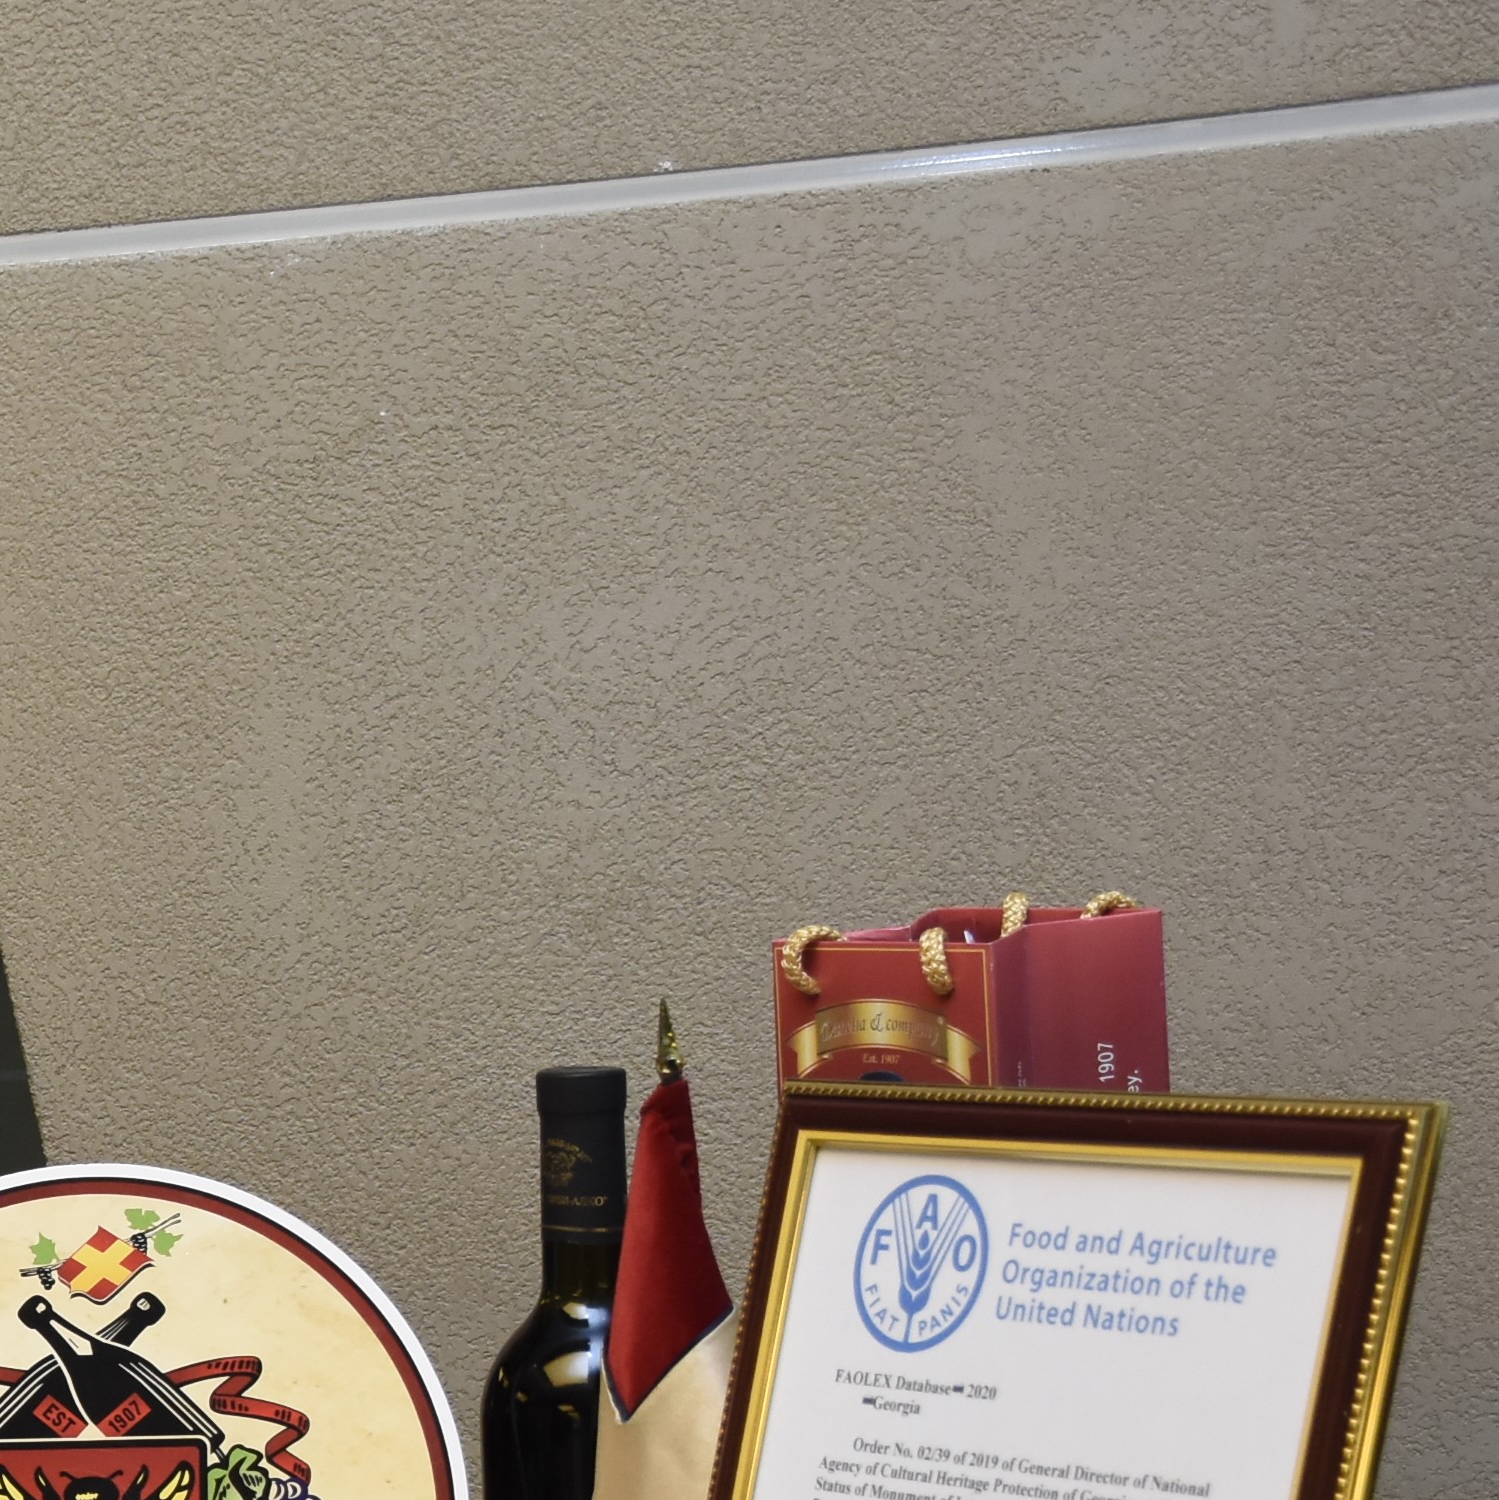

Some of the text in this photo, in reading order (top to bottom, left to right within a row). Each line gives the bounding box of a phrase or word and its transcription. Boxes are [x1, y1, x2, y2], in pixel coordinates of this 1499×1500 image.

[880, 1054, 899, 1065] 1907
[1098, 1042, 1115, 1082] 1907
[1008, 1223, 1277, 1268] Food and Agriculture
[1002, 1260, 1245, 1304] Organization of the
[996, 1298, 1180, 1337] United Nations
[834, 1368, 998, 1401] FAOLEX Database 2020
[42, 1400, 141, 1433] EST 1907
[873, 1395, 921, 1416] Georgia
[852, 1436, 1211, 1498] Order No. 02/39 of 2019 of General Director of National
[814, 1476, 852, 1496] Status
[853, 1482, 870, 1498] of
